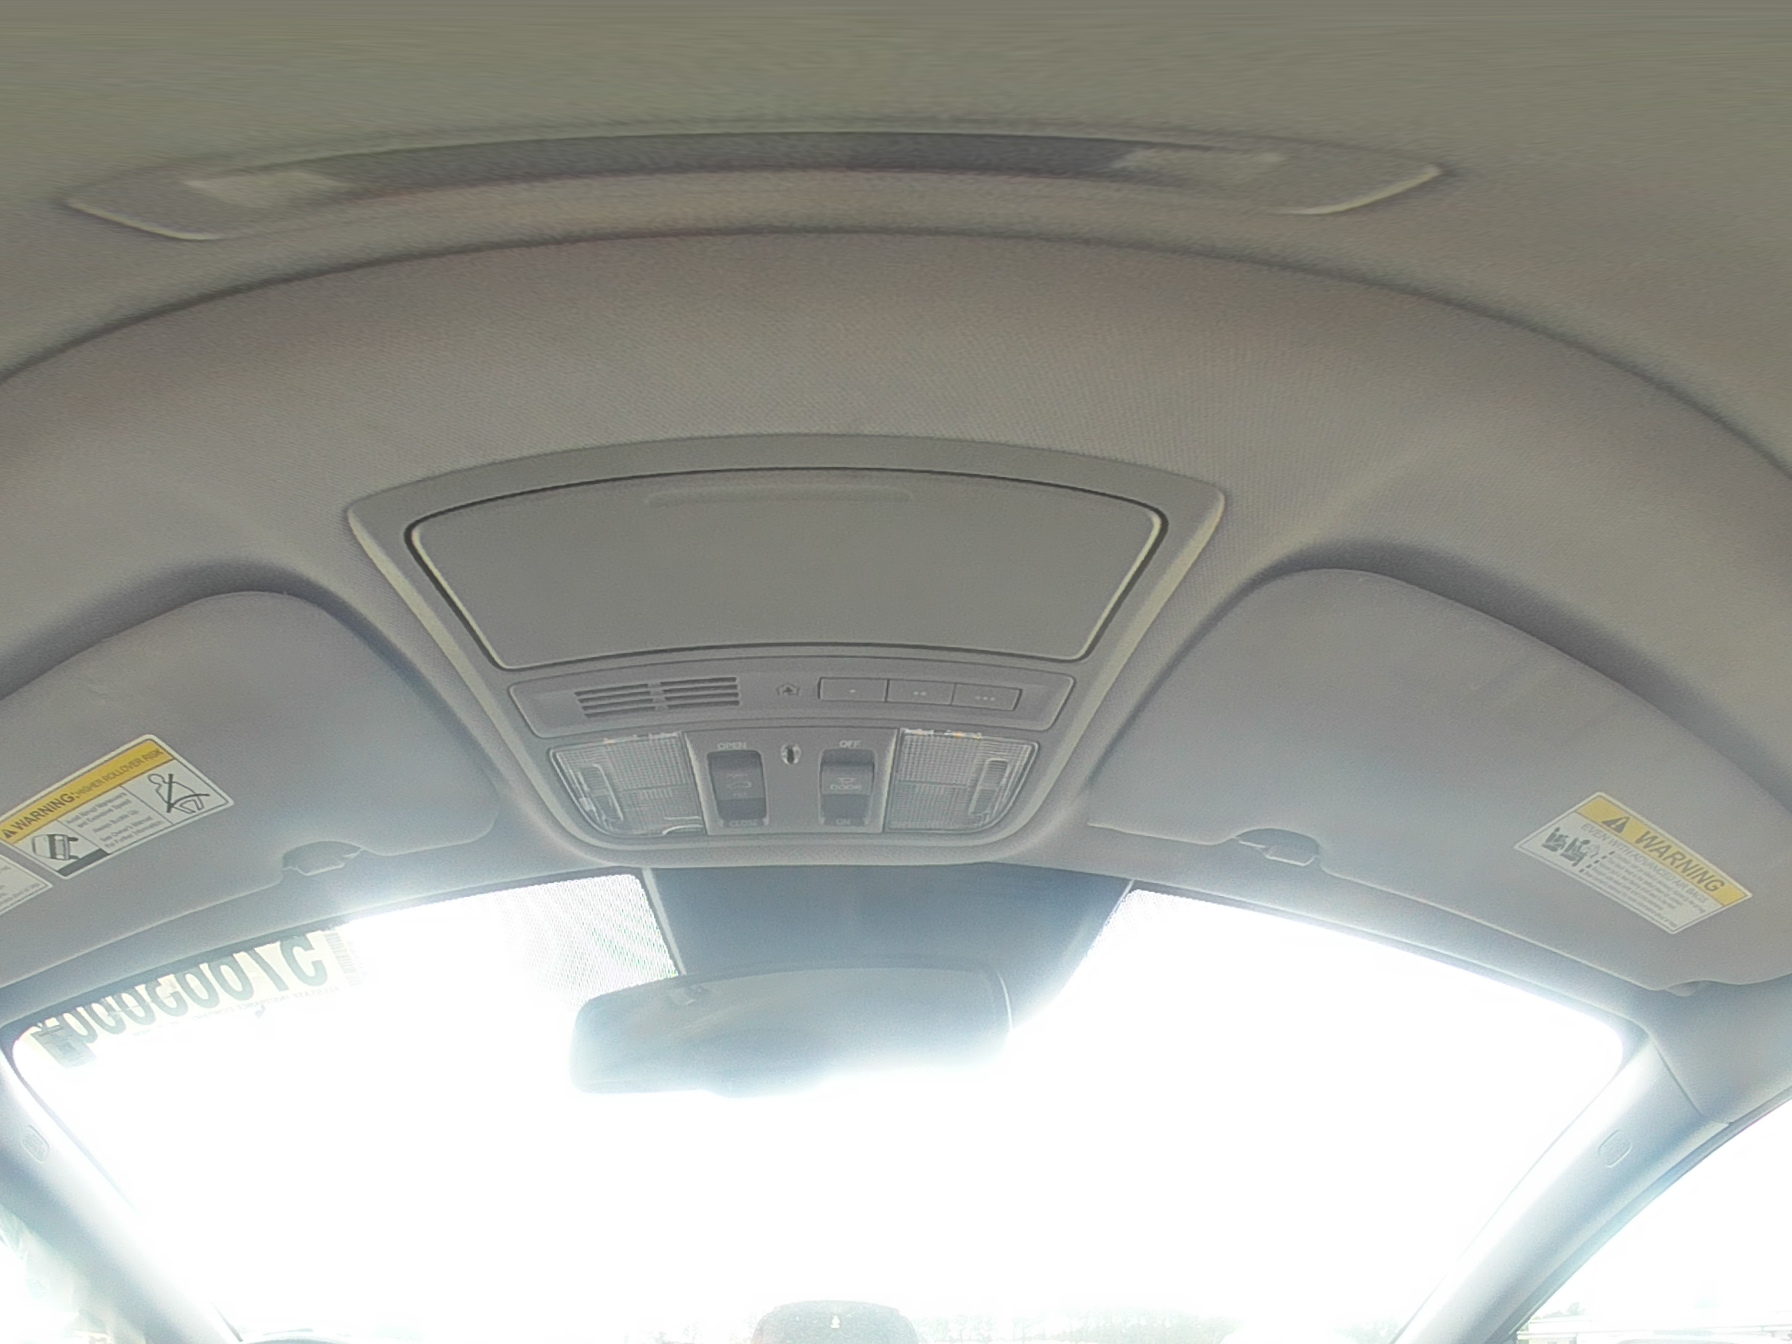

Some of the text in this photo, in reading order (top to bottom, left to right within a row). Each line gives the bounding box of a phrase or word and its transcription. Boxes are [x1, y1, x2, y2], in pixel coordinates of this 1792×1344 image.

[716, 741, 747, 750] OPEN
[839, 740, 861, 748] OFF
[1635, 830, 1725, 892] WARNING
